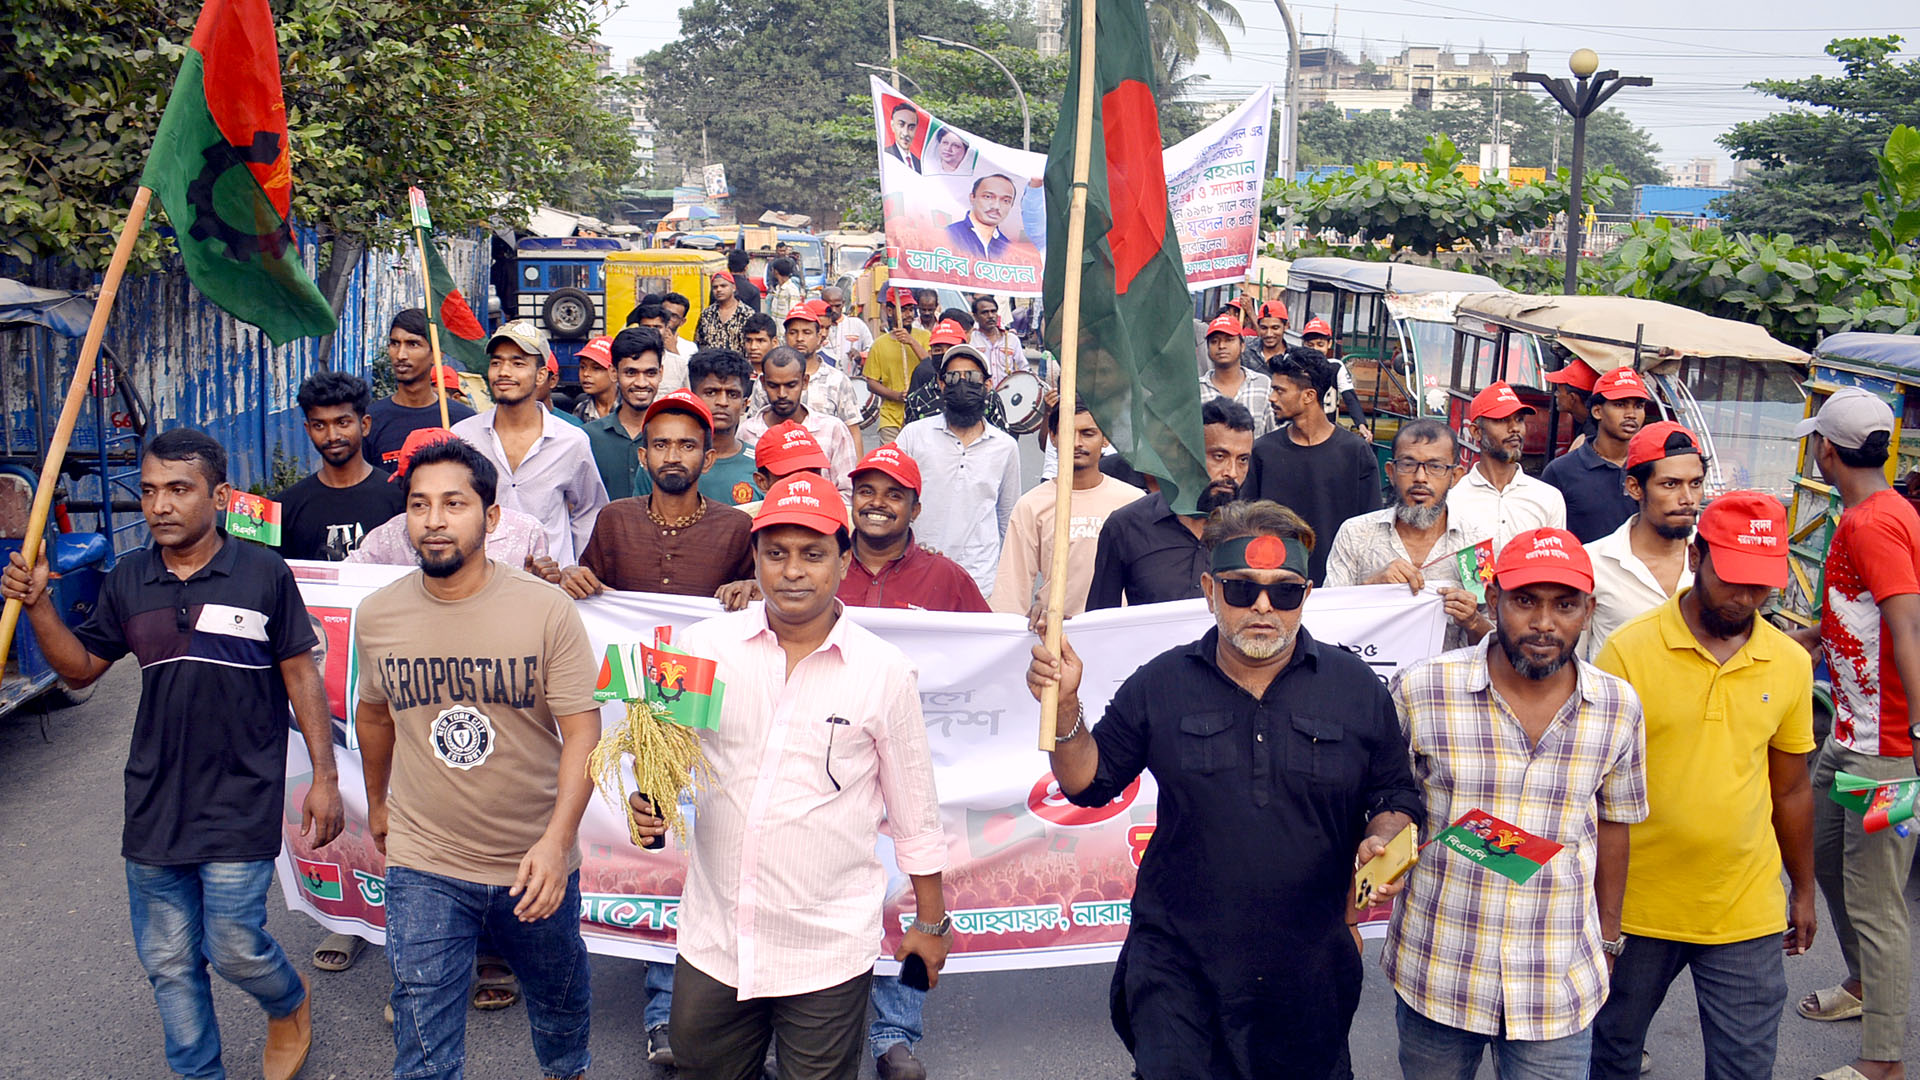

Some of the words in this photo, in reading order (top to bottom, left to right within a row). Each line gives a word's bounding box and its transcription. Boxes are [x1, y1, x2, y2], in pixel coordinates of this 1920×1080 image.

[1203, 160, 1255, 181] রহমান
[1198, 186, 1207, 200] ও
[1209, 180, 1244, 197] সালাম
[1246, 180, 1257, 191] জা
[1186, 204, 1214, 217] ১৯৭৮
[1217, 200, 1237, 212] সালে
[1187, 216, 1223, 238] যুবদল
[1226, 216, 1236, 229] কে
[906, 247, 968, 276] জাকির
[975, 261, 1036, 284] হোসেন
[788, 480, 811, 496] যুবদল
[1749, 520, 1772, 535] যুবদল
[436, 719, 449, 737] NEW
[447, 712, 471, 721] YORK
[471, 717, 487, 733] CITY
[1445, 834, 1487, 861] বিএনপি
